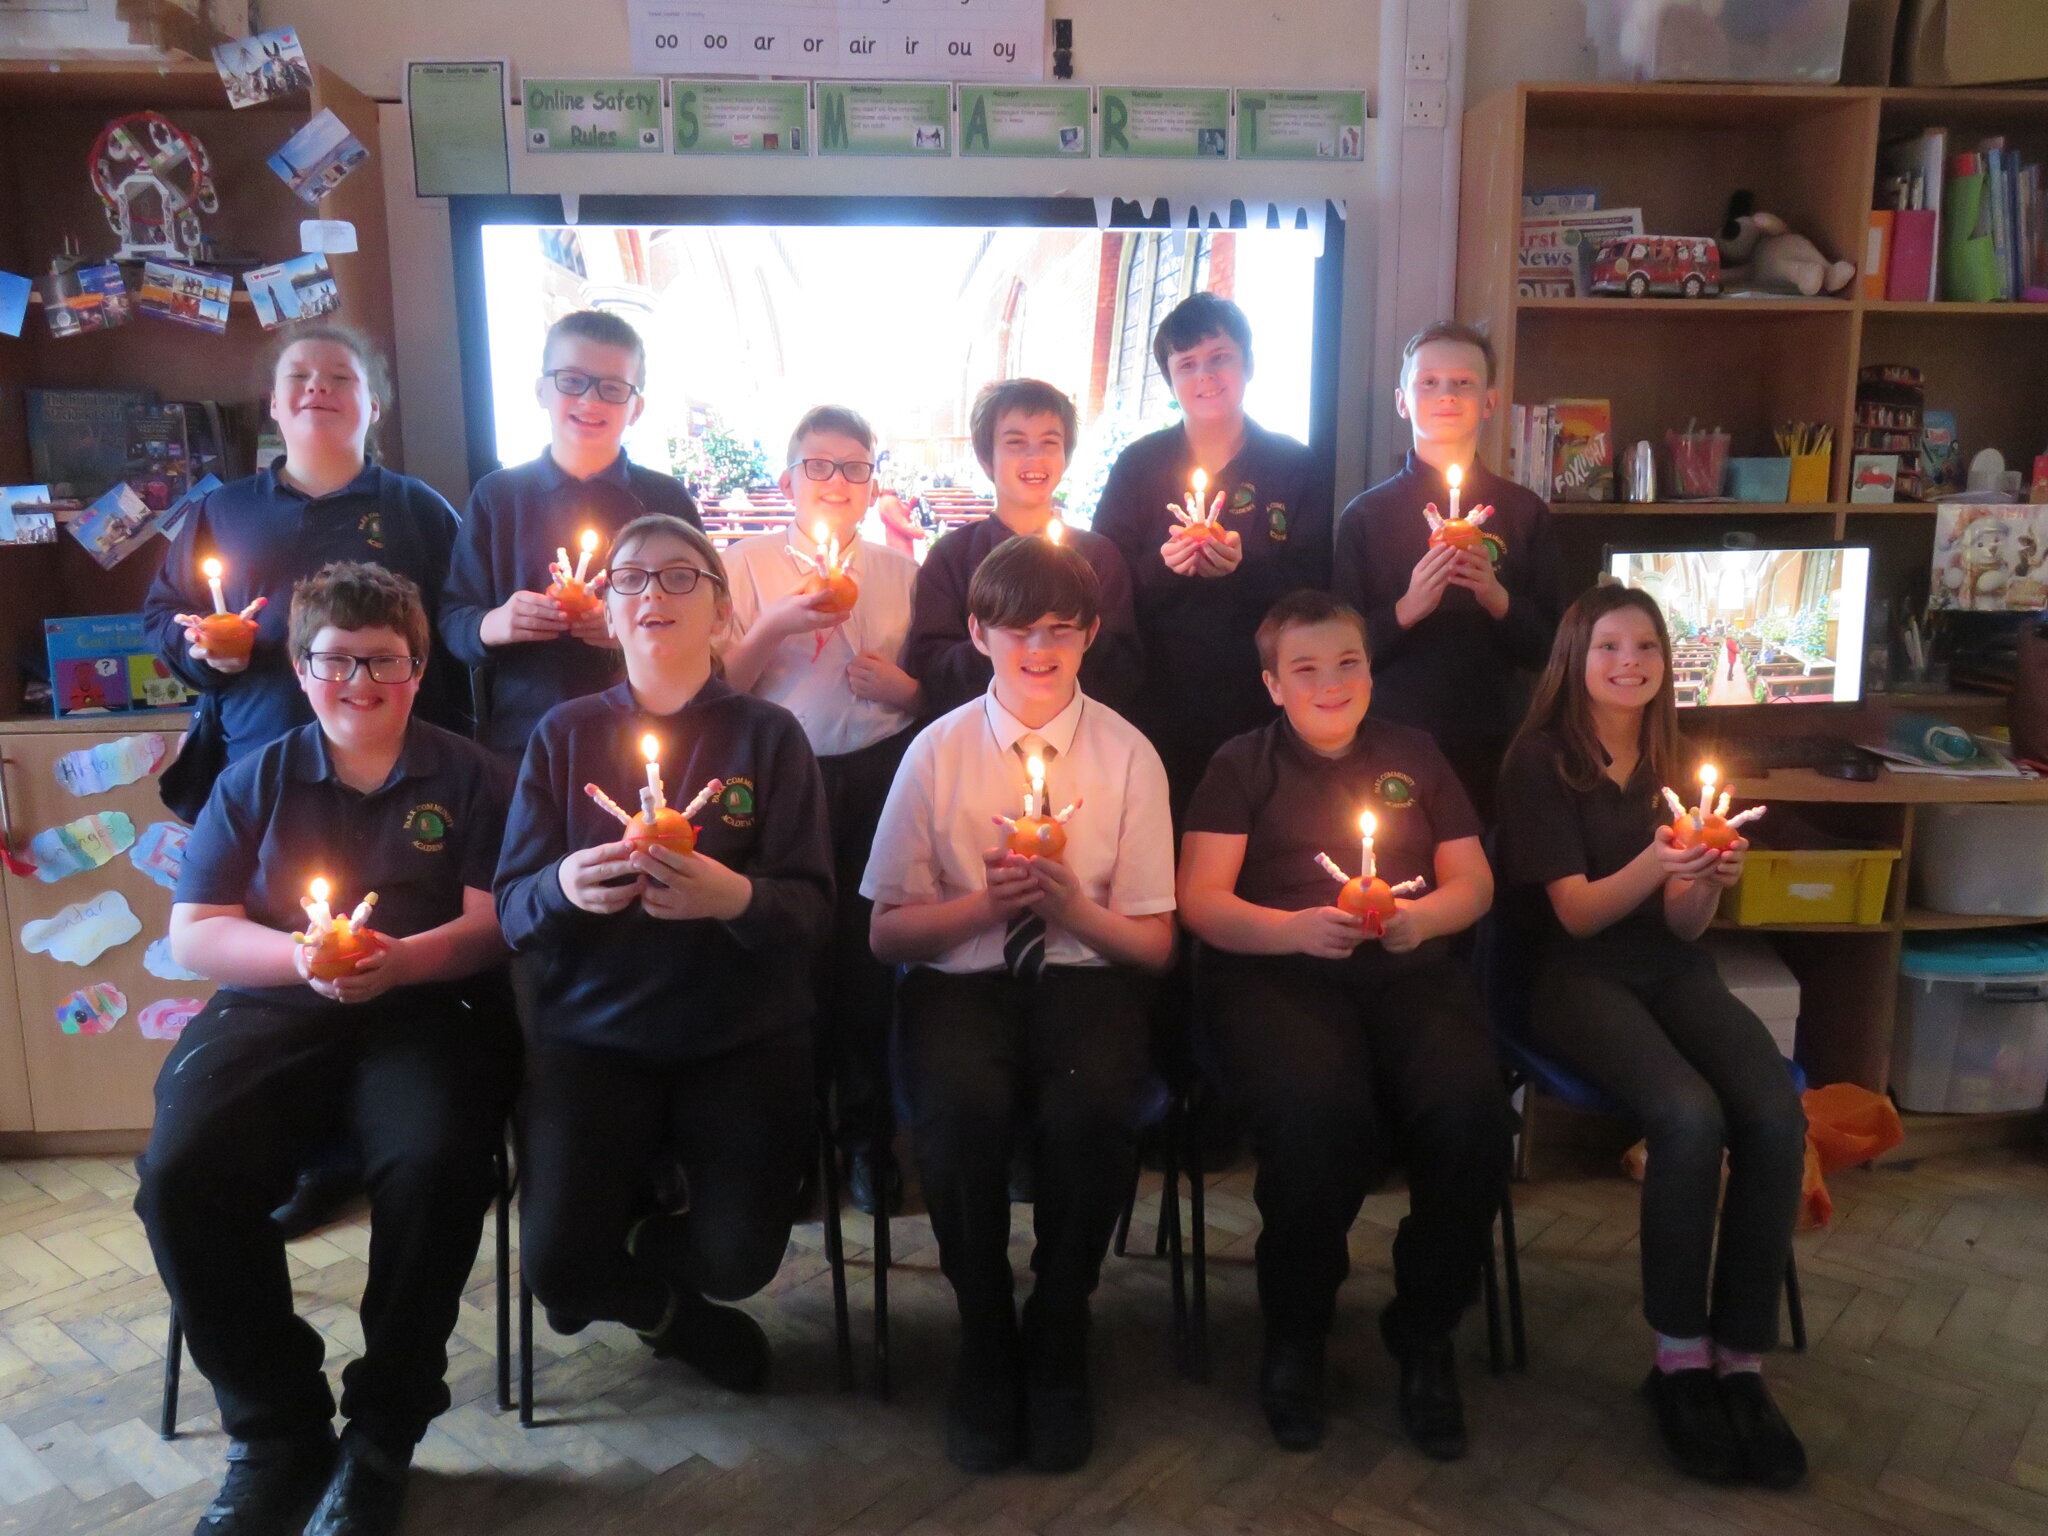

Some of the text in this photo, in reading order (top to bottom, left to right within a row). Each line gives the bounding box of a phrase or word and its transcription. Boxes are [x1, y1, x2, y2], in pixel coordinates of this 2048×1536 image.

[654, 34, 1016, 62] oo oo ar or air ir ou oy
[530, 88, 654, 116] Online Safety
[678, 90, 699, 148] S
[823, 91, 848, 149] M
[965, 94, 989, 151] A
[570, 124, 617, 146] Rules
[1104, 95, 1128, 151] R
[1241, 98, 1266, 153] T
[1518, 229, 1558, 248] irst
[1518, 249, 1573, 267] News
